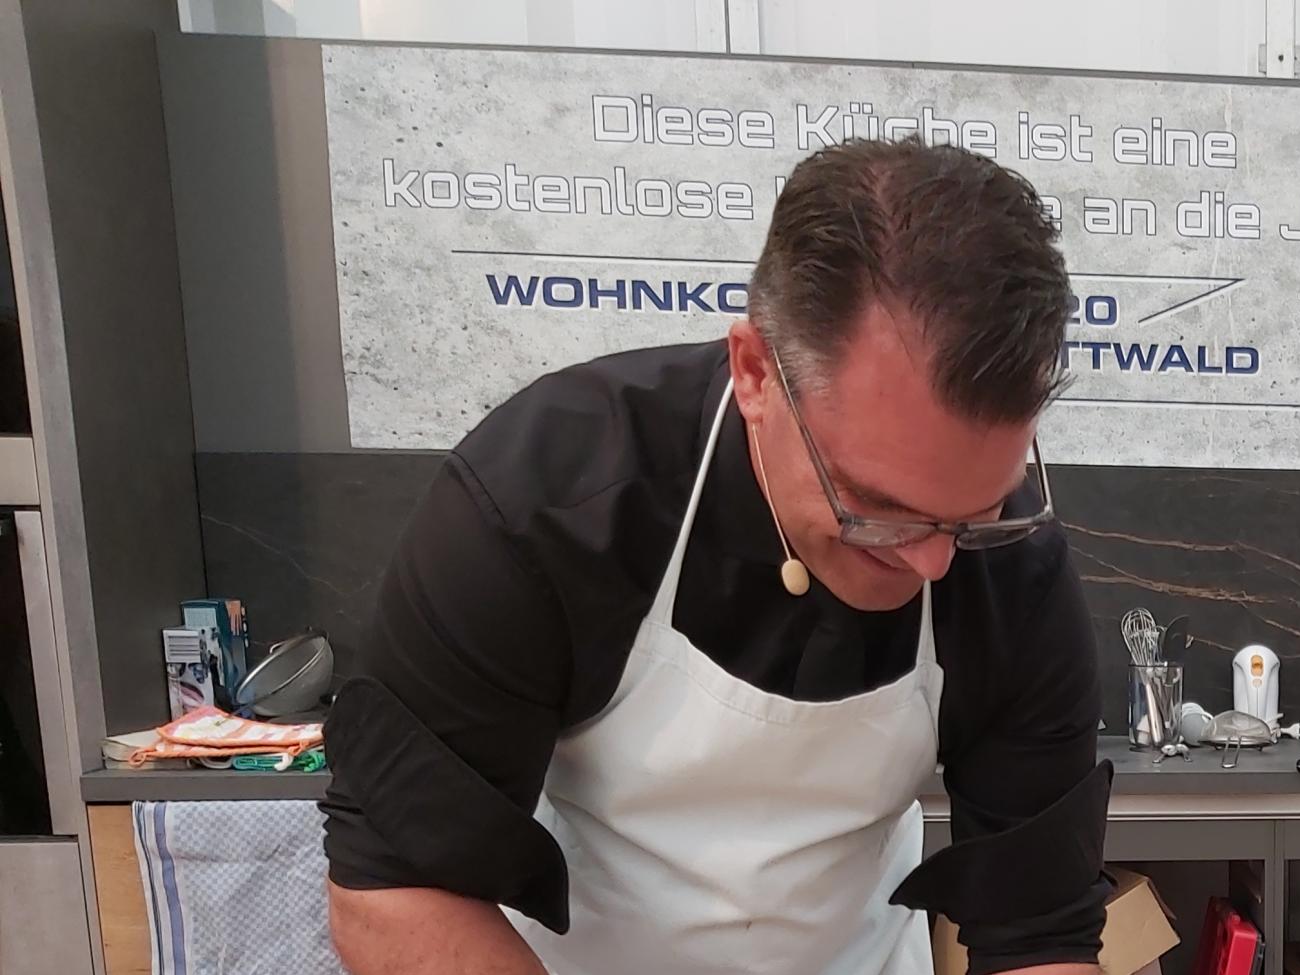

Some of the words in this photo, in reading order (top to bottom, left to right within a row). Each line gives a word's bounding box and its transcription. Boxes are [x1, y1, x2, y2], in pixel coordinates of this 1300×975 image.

[591, 94, 775, 149] Diese
[1017, 111, 1093, 163] ist
[1113, 117, 1238, 169] eine
[383, 158, 754, 221] kostenlose
[1083, 196, 1157, 236] an
[1177, 190, 1261, 239] die
[486, 273, 751, 314] WOHNKO
[1061, 341, 1261, 376] TTWALD
